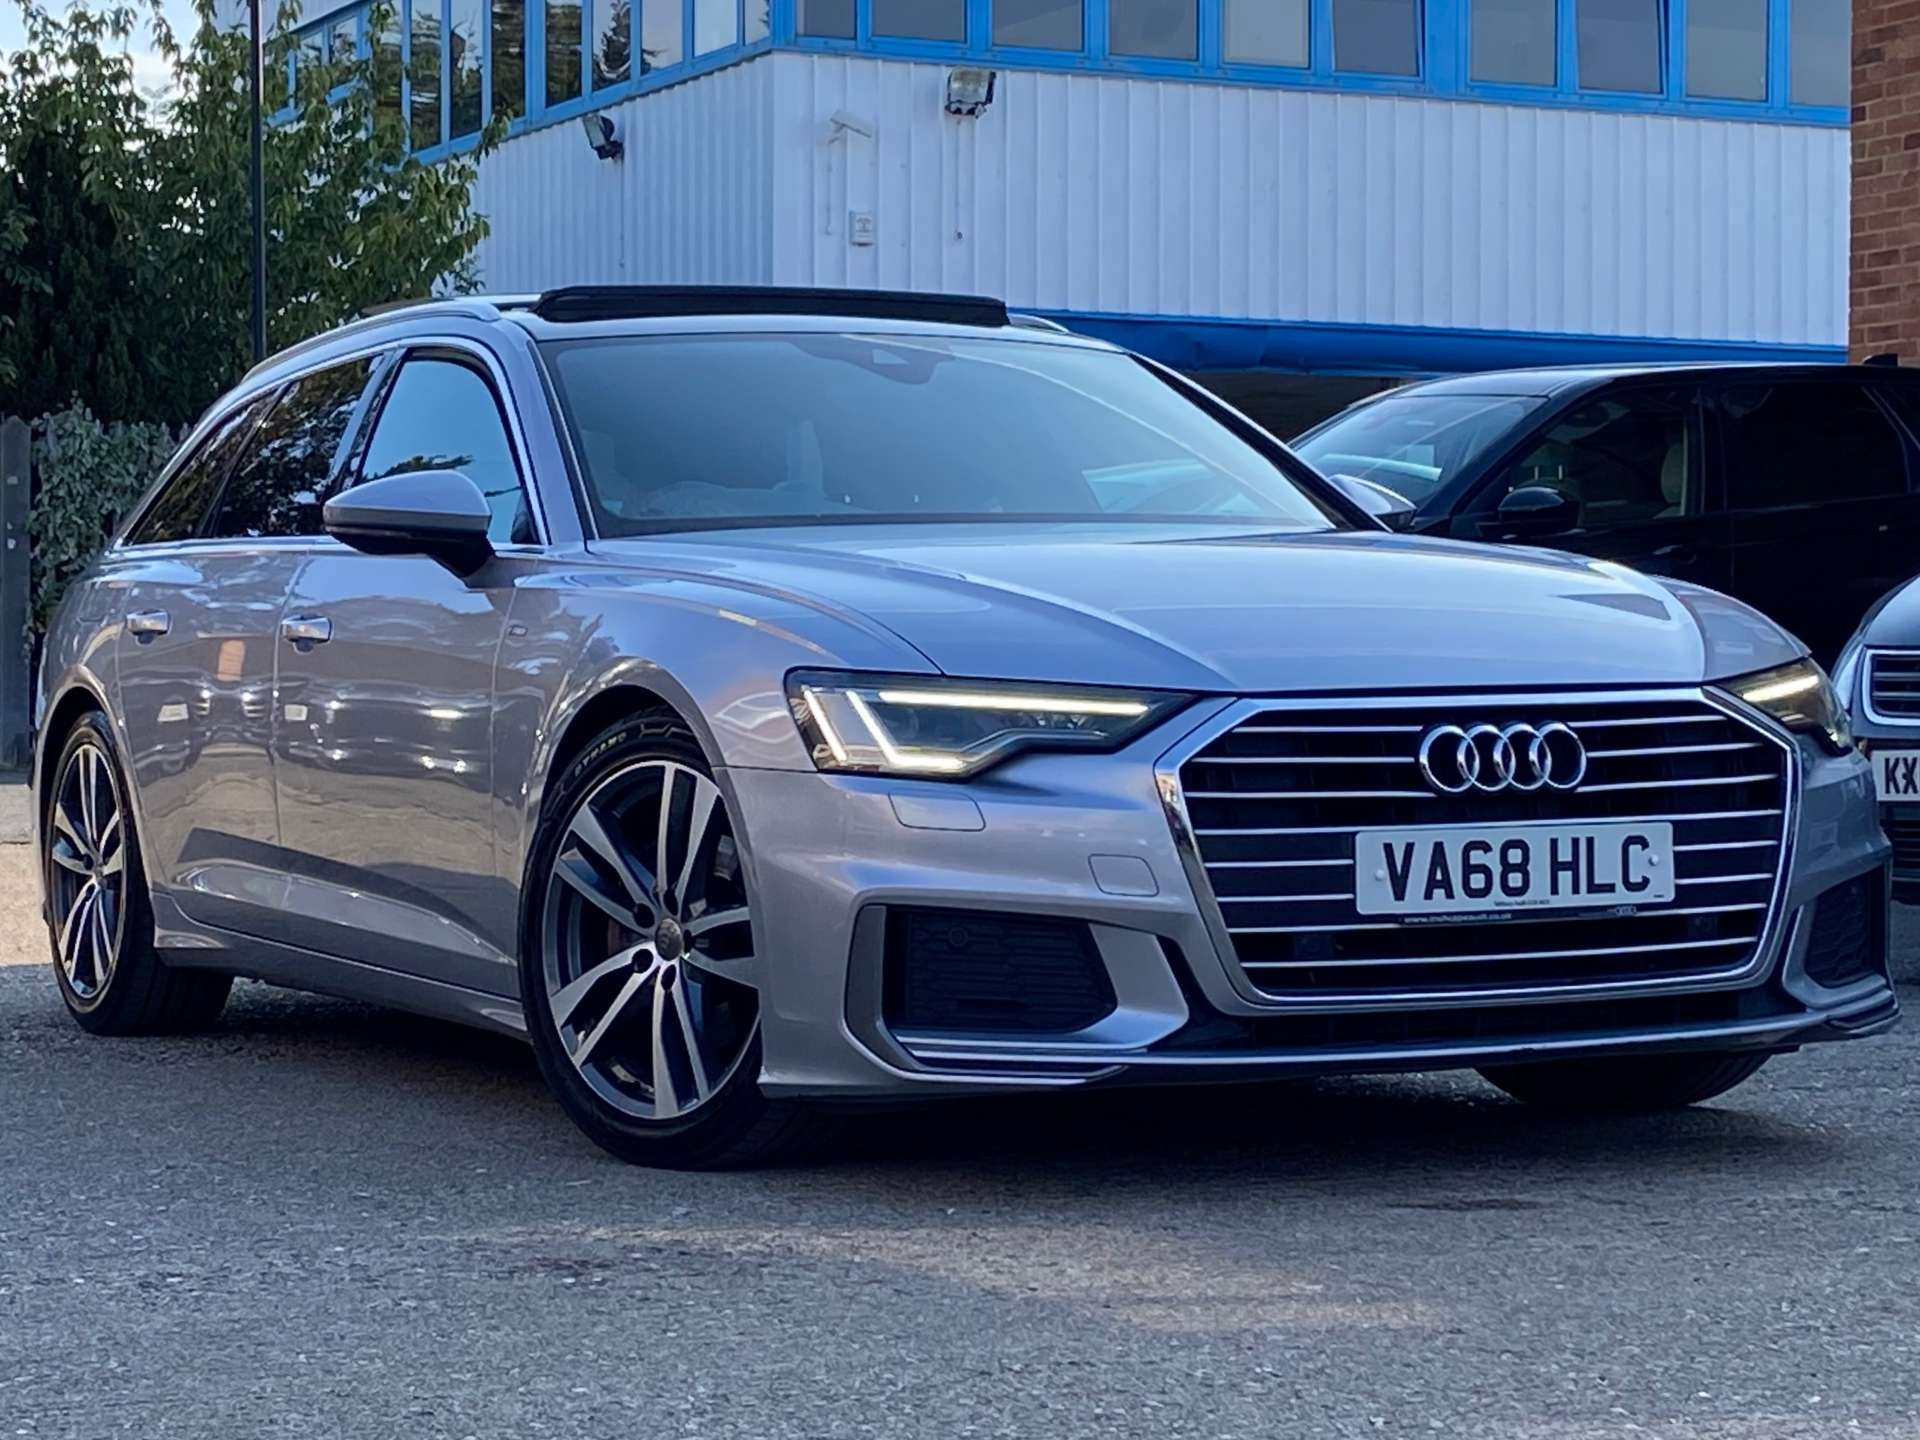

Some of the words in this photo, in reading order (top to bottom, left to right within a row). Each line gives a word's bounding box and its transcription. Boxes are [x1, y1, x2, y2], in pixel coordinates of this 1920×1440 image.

[1885, 757, 1919, 794] KX
[1383, 839, 1531, 901] VA68
[1550, 835, 1651, 896] HLC
